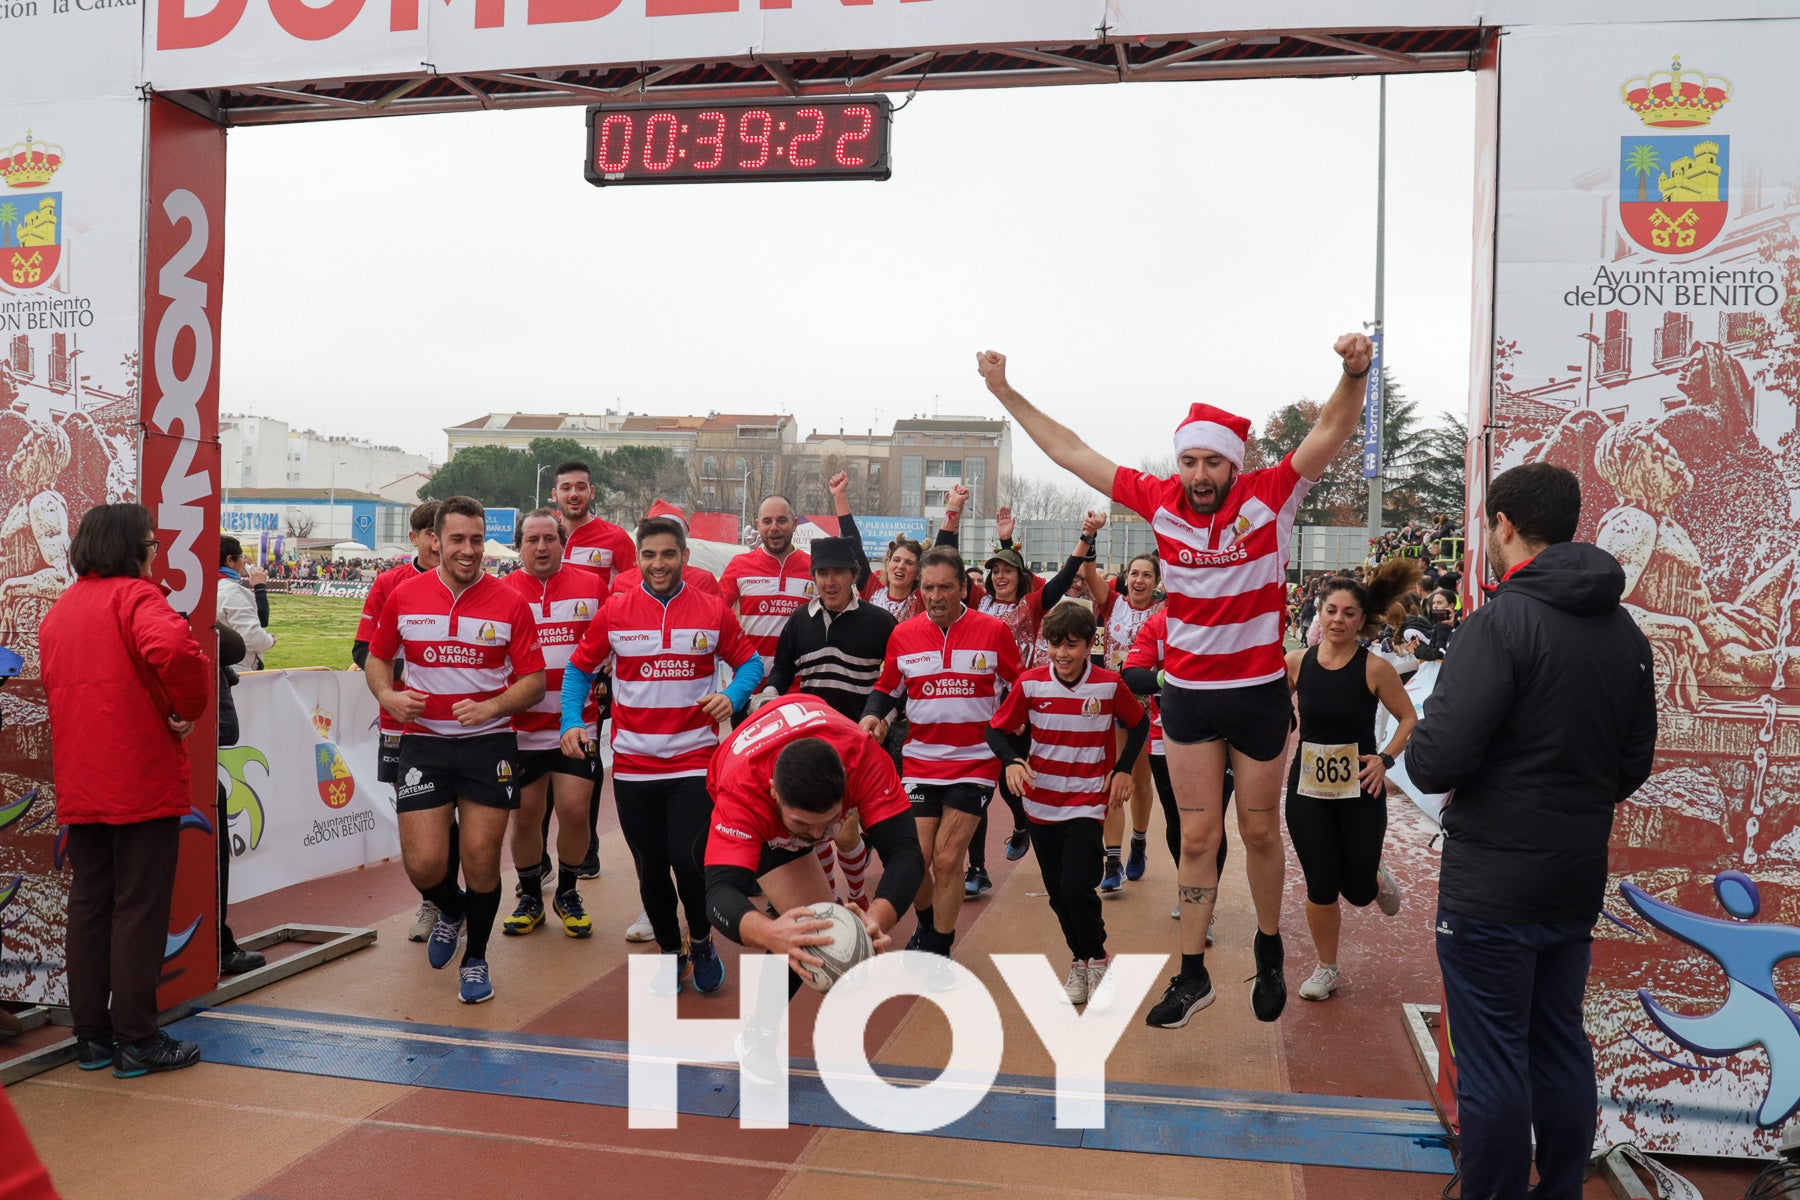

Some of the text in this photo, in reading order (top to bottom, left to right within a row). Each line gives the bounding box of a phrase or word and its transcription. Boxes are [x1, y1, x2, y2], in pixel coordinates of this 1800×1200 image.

[600, 107, 873, 171] 00:39:22
[1593, 265, 1775, 291] Ayuntamiento
[1564, 284, 1779, 306] deDON BENITO
[27, 309, 94, 330] BENITO
[1195, 548, 1248, 565] BARROS
[770, 599, 799, 608] VEGAS
[537, 627, 568, 636] VEGAS
[438, 646, 477, 657] VEGAS
[438, 655, 484, 665] BARROS
[653, 660, 690, 669] VEGAS
[653, 669, 695, 678] BARROS
[935, 679, 969, 687] VEGAS
[935, 687, 975, 696] BARROS
[1315, 756, 1351, 783] 863
[312, 810, 374, 833] Ayuntamiento
[342, 817, 376, 837] BENITO
